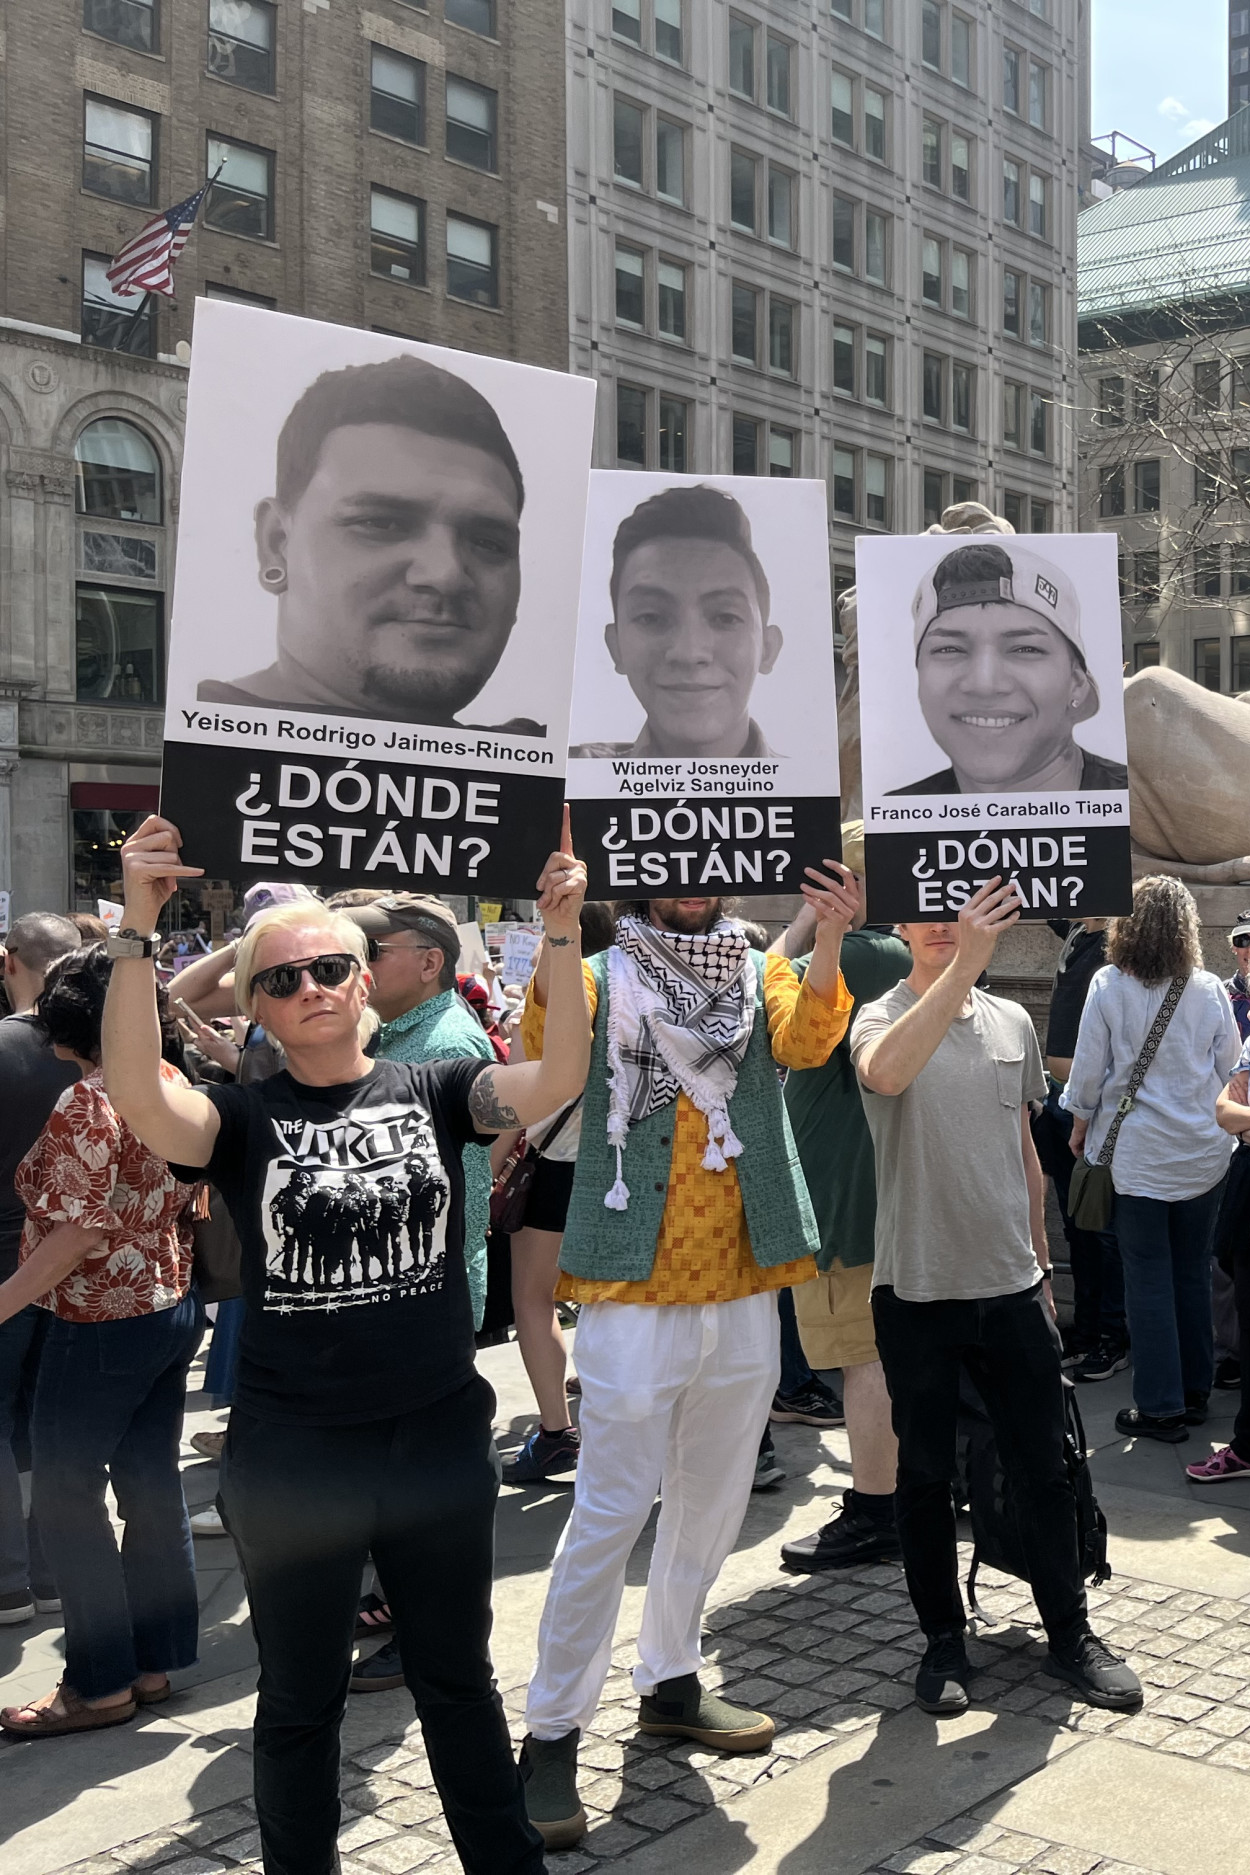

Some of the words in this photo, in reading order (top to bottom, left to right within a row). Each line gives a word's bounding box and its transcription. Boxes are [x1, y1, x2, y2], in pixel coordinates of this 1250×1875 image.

[182, 710, 267, 735] Yeison
[278, 720, 375, 749] Rodrigo
[384, 732, 553, 764] Jaimes-Rincon
[236, 760, 500, 824] ¿DÓNDE
[612, 762, 682, 775] Widmer
[687, 762, 779, 779] Josneyder
[619, 779, 685, 795] Agelviz
[691, 778, 773, 794] Sanguino
[602, 800, 794, 850] ¿DÓNDE
[871, 807, 932, 820] Franco
[939, 804, 980, 818] José
[987, 802, 1070, 816] Caraballo
[1076, 801, 1122, 816] Tiapa
[241, 820, 490, 877] ESTÁN?
[609, 841, 790, 886] ESTÁN?
[912, 831, 1087, 878] ¿DÓNDE
[281, 1119, 303, 1135] THE
[371, 1294, 391, 1303] NO
[400, 1281, 443, 1298] PEACE
